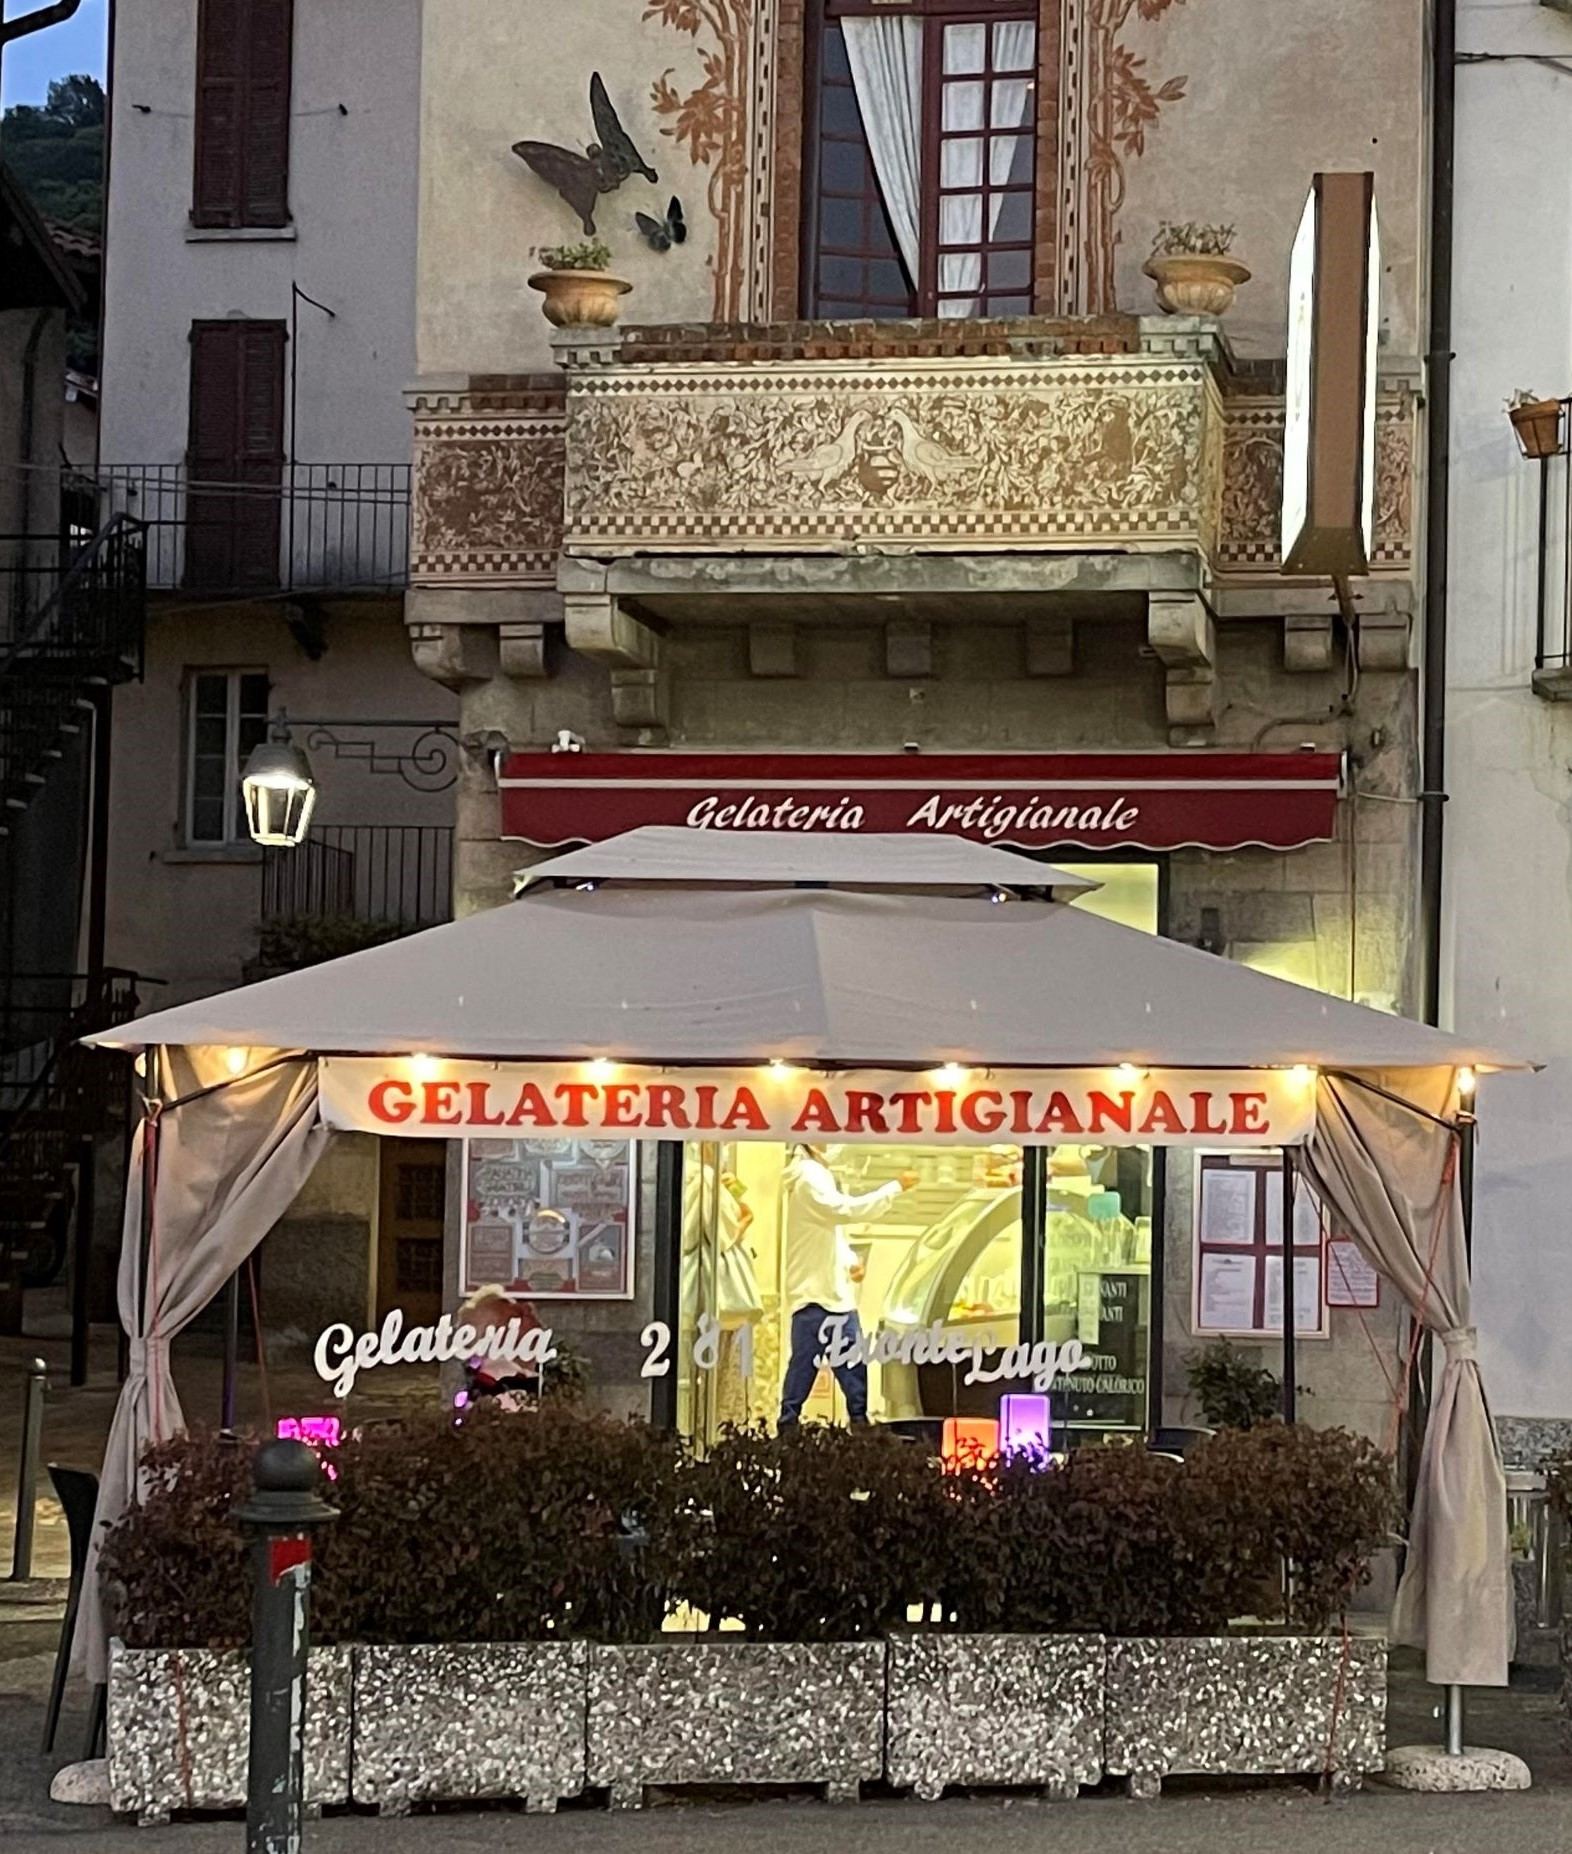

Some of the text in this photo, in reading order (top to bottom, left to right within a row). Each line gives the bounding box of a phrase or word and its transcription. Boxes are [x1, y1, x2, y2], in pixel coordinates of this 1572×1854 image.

[686, 795, 1139, 839] Gelateria Artigianale
[368, 1080, 1271, 1136] GELATERIA ARTIGIANALE
[314, 1309, 557, 1398] Gelateria
